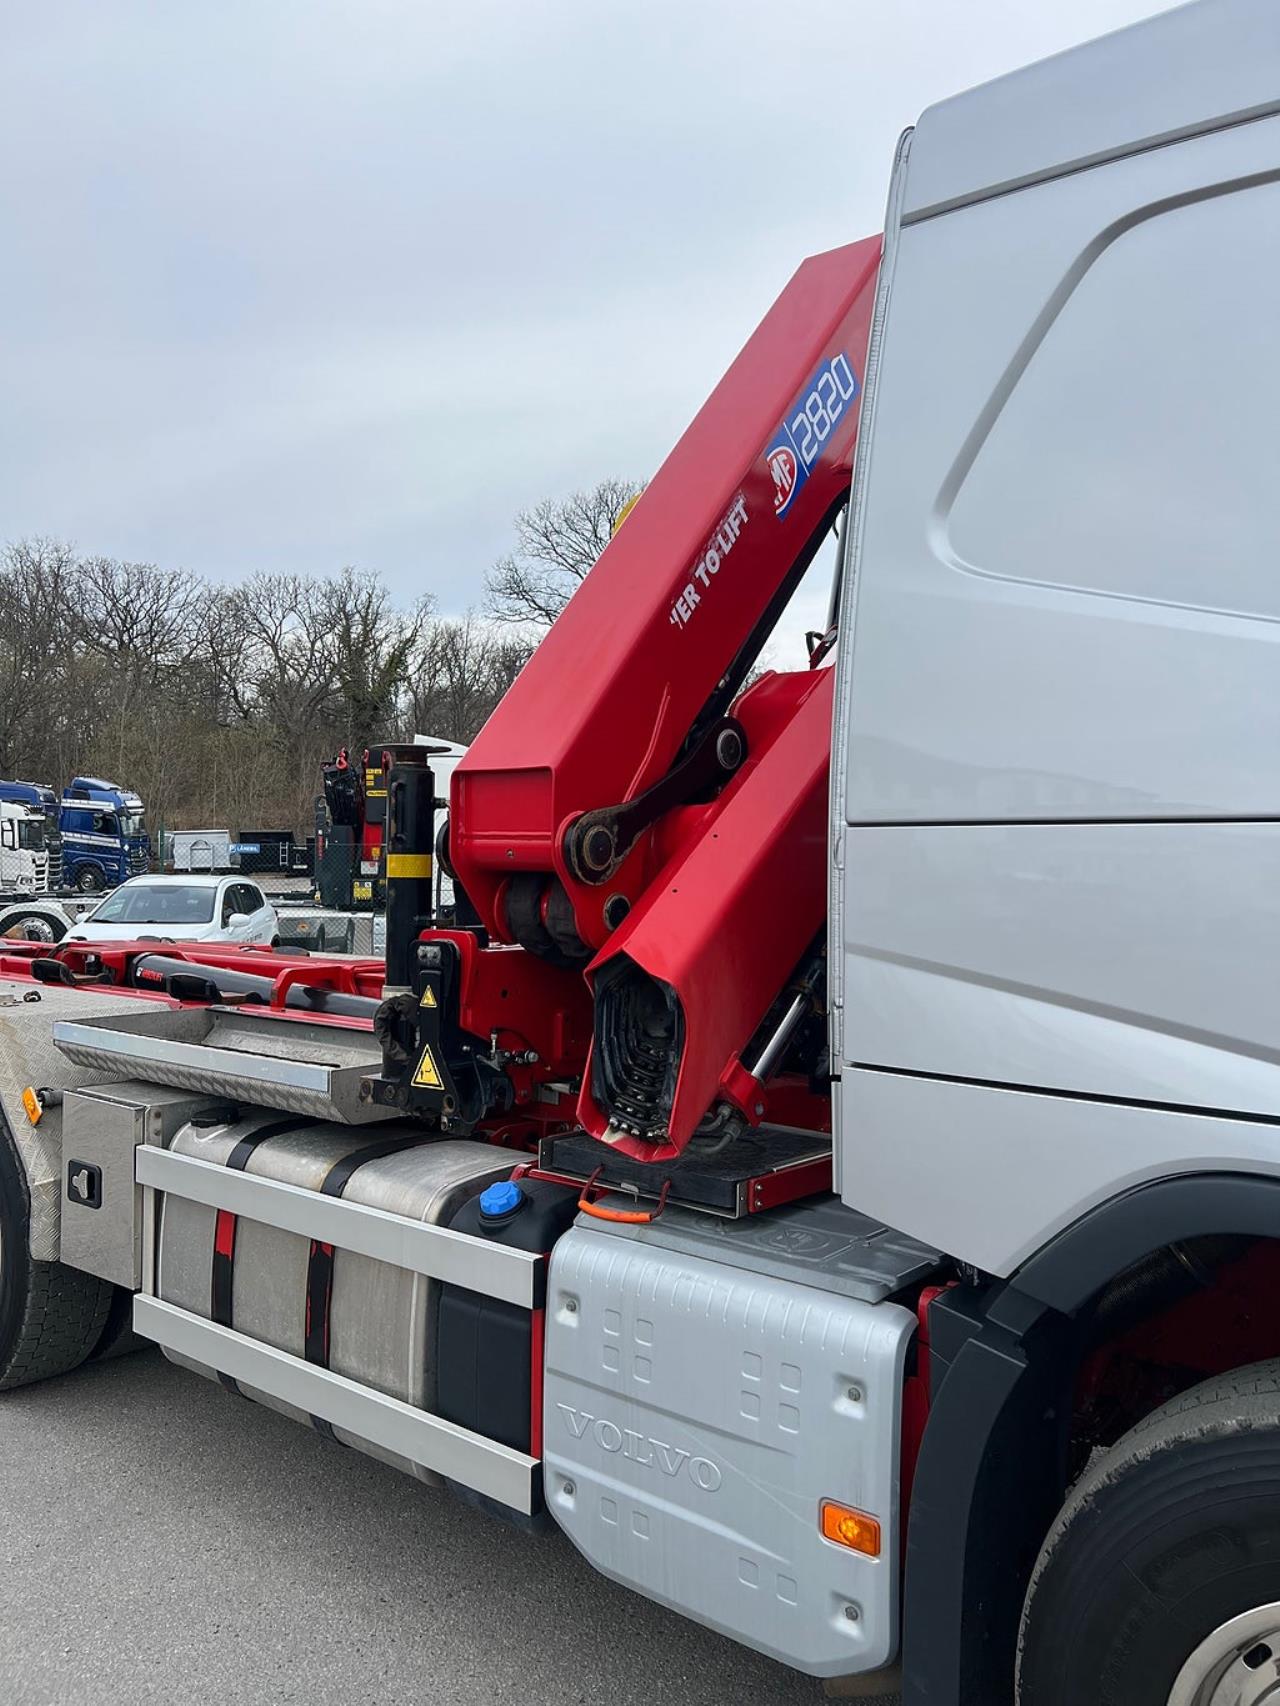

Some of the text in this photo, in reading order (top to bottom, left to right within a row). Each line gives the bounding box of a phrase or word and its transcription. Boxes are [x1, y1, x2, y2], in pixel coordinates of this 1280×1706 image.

[791, 353, 854, 467] 2820
[695, 548, 721, 588] TO
[717, 498, 749, 555] LIFT
[556, 1402, 722, 1492] VOLVO
